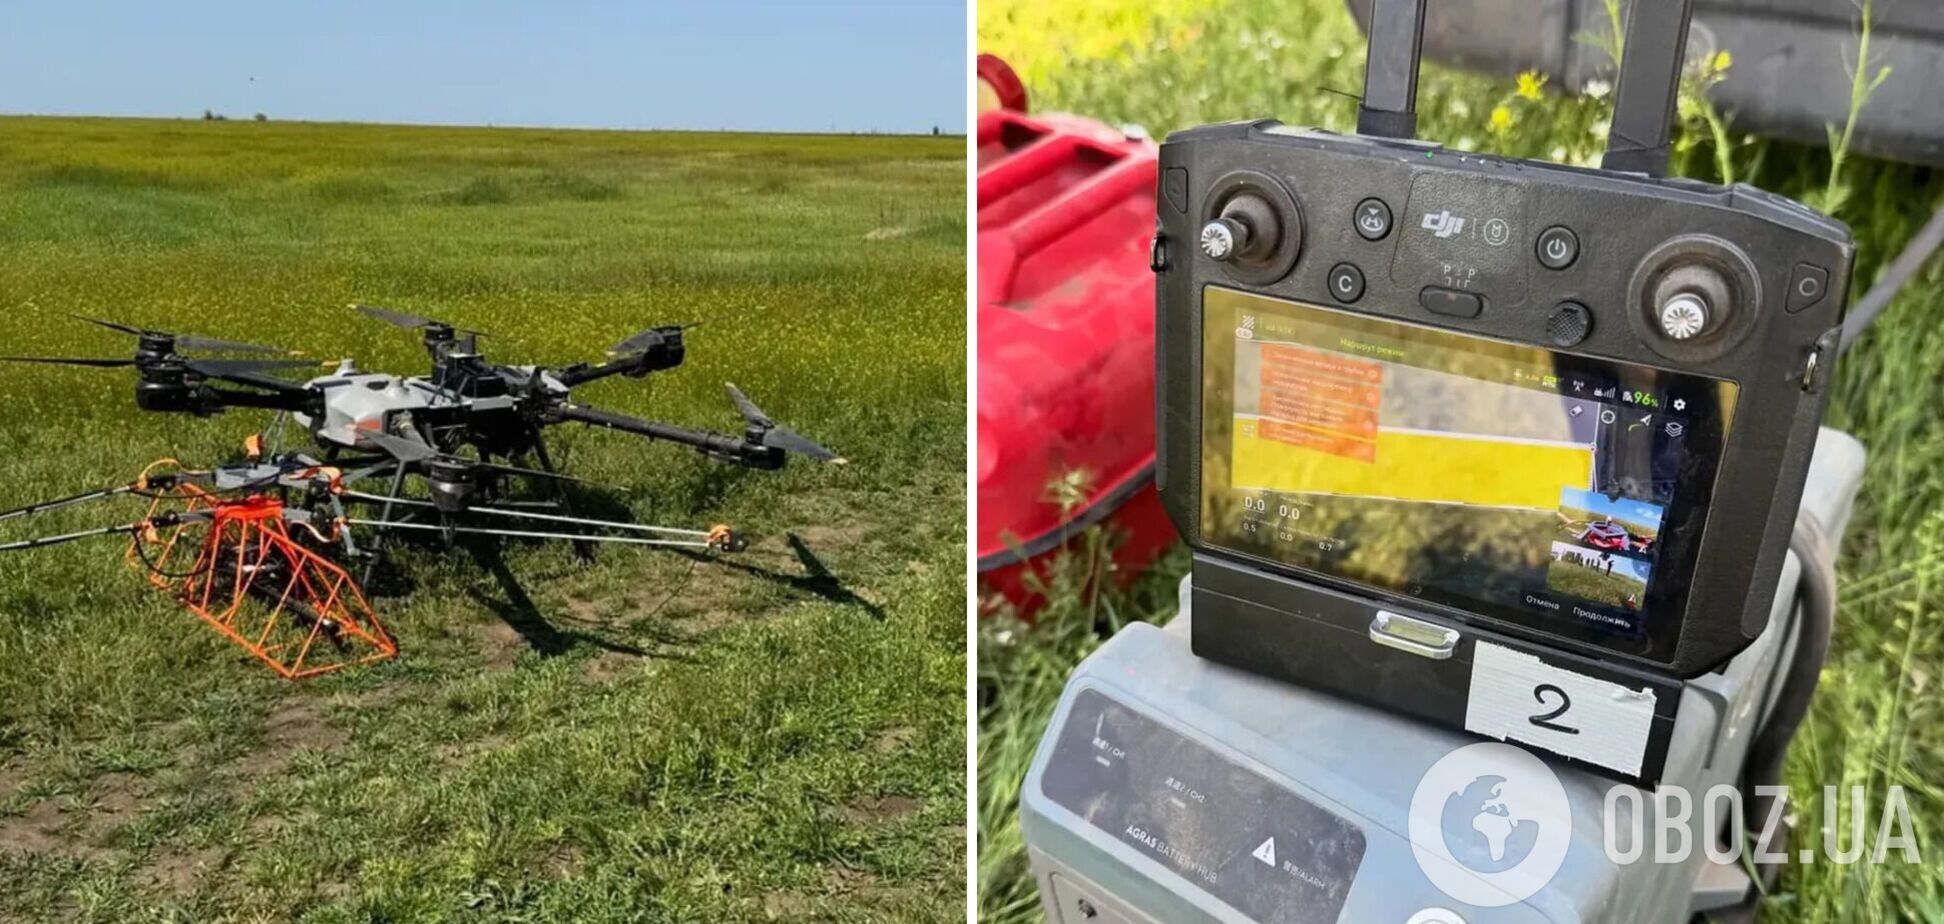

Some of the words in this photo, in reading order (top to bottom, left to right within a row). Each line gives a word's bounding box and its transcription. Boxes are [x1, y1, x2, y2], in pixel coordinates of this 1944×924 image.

[1338, 275, 1353, 293] C
[1244, 495, 1265, 511] 0.0
[1279, 504, 1300, 520] 0.0
[1526, 594, 1560, 611] Отмена
[1528, 684, 1580, 735] 2
[1126, 825, 1158, 849] AGRAS
[1157, 841, 1198, 872] BATTERY
[1197, 865, 1218, 884] HUB
